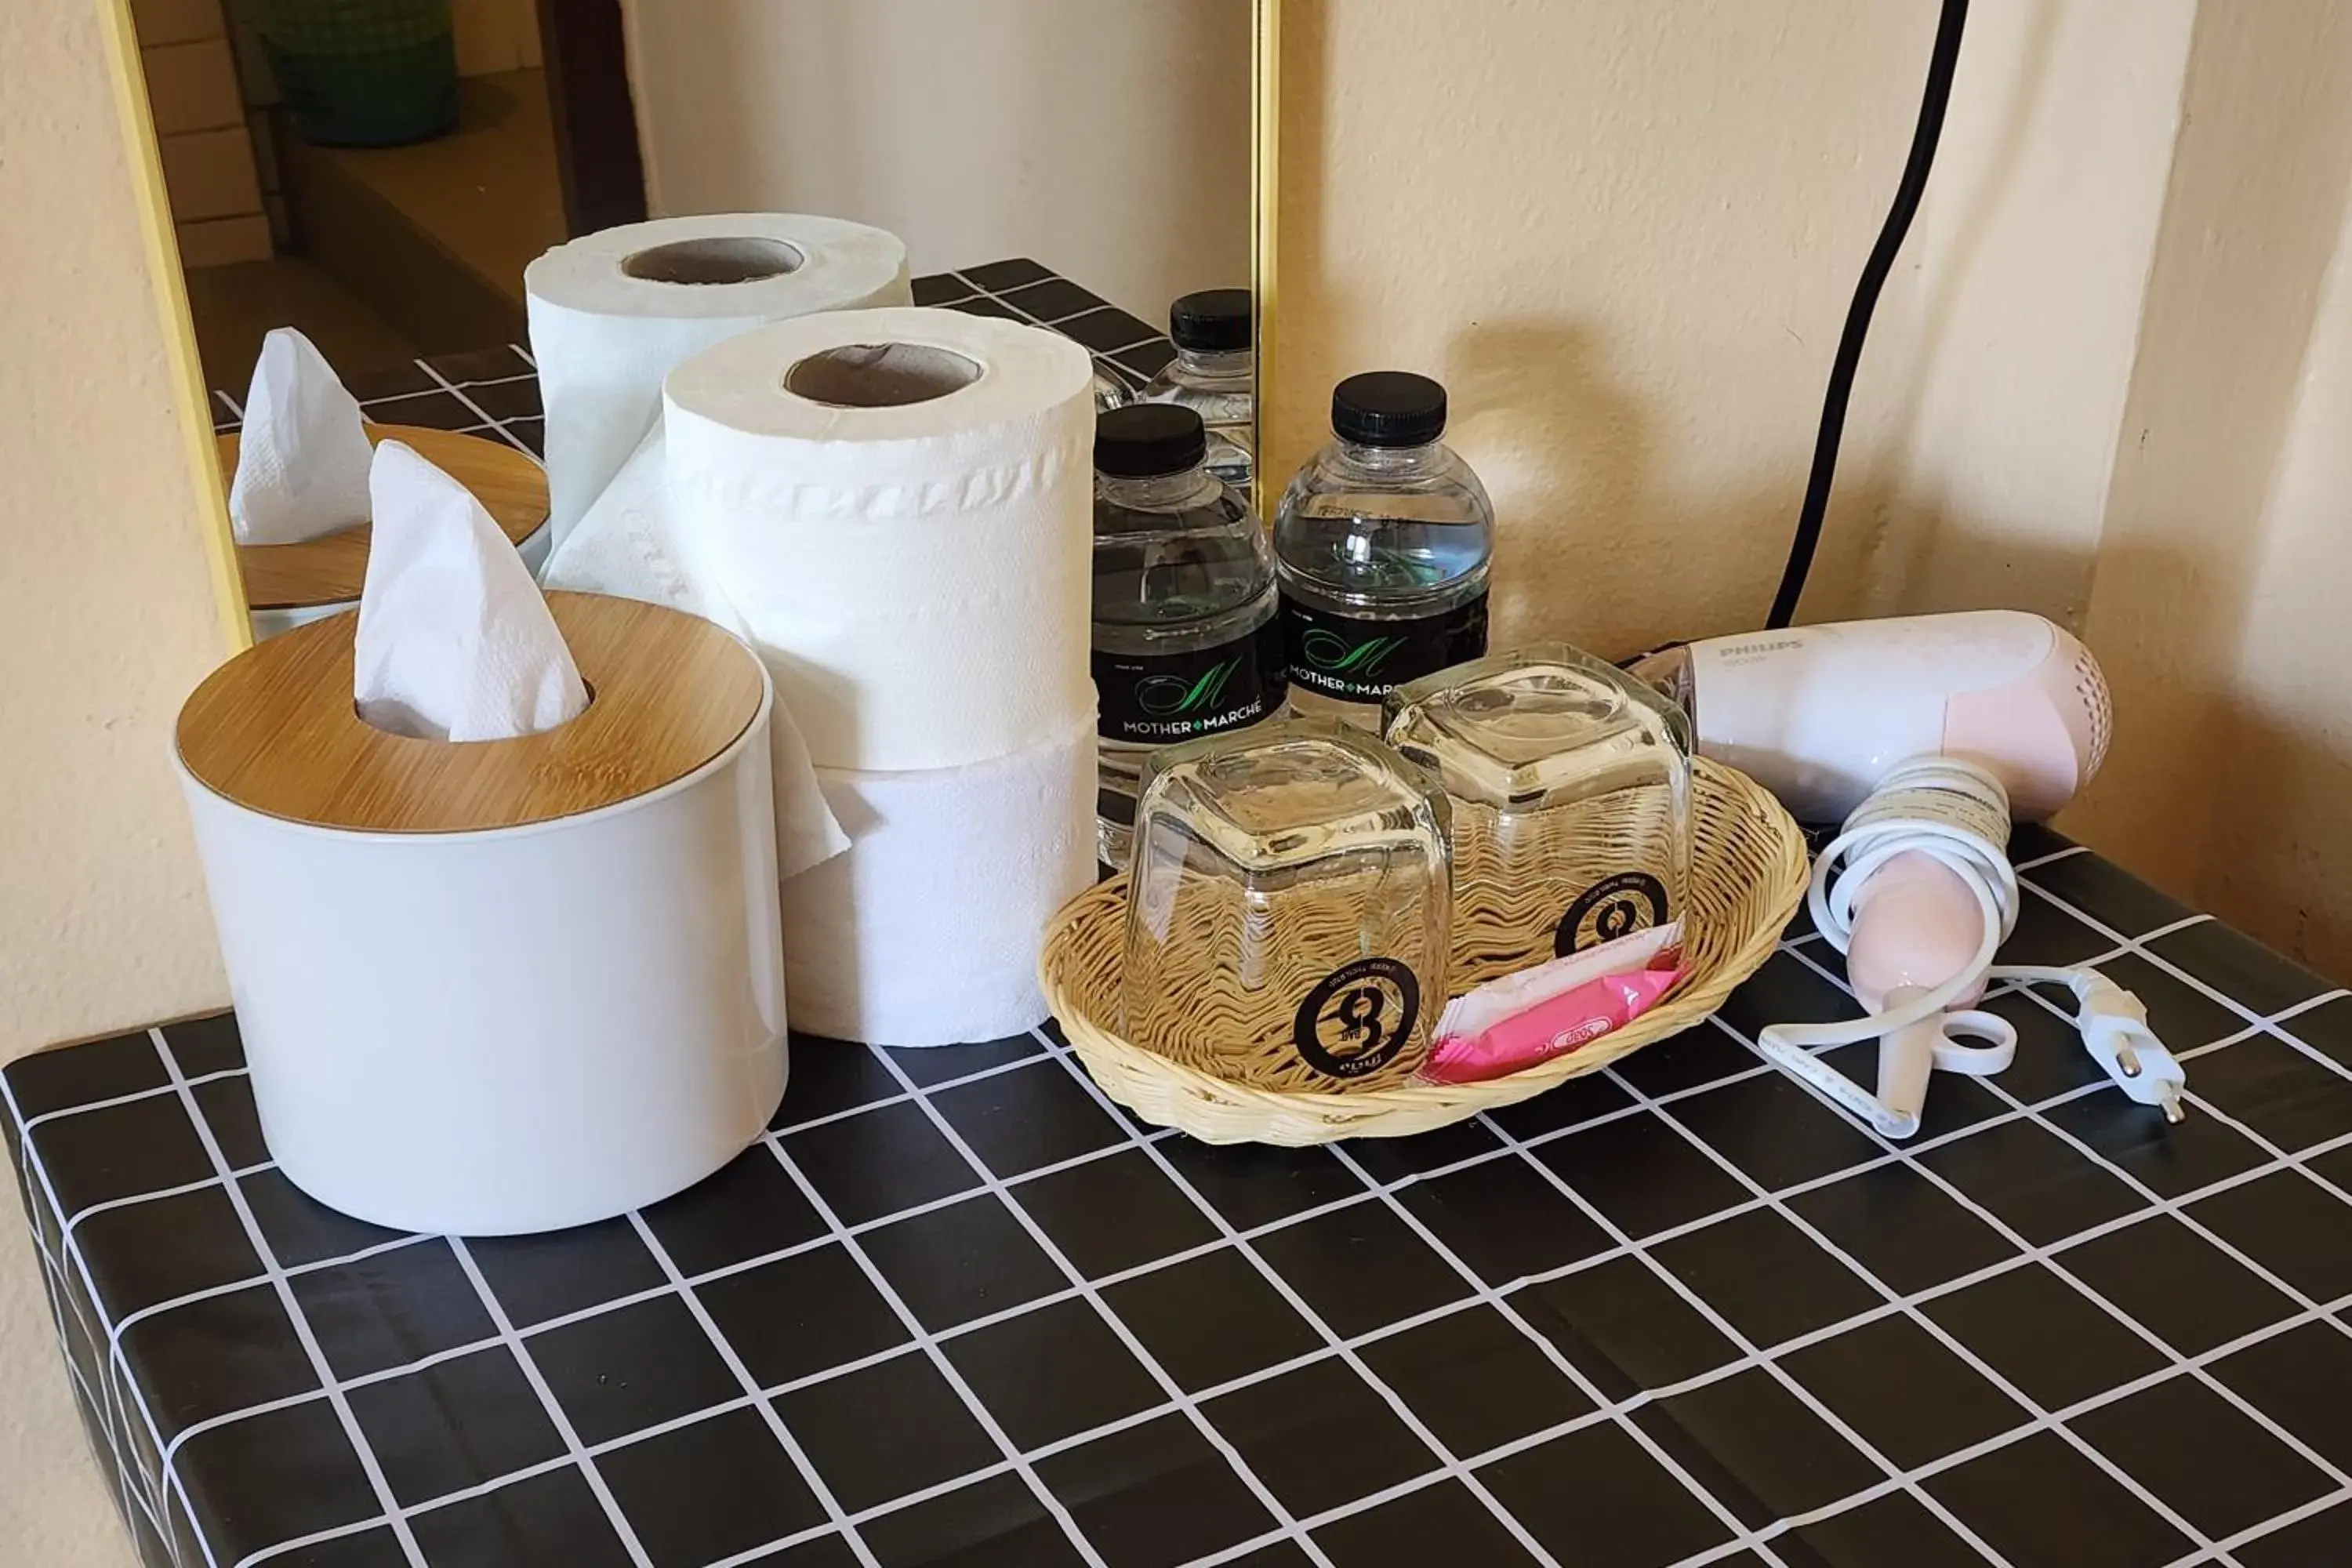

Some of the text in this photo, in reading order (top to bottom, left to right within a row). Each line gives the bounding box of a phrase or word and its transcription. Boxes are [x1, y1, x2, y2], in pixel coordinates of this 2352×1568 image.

[1719, 639, 1804, 657] PHILIPS
[1289, 664, 1345, 691] MOTHER
[1123, 695, 1261, 735] MOTHER MARCHÉ
